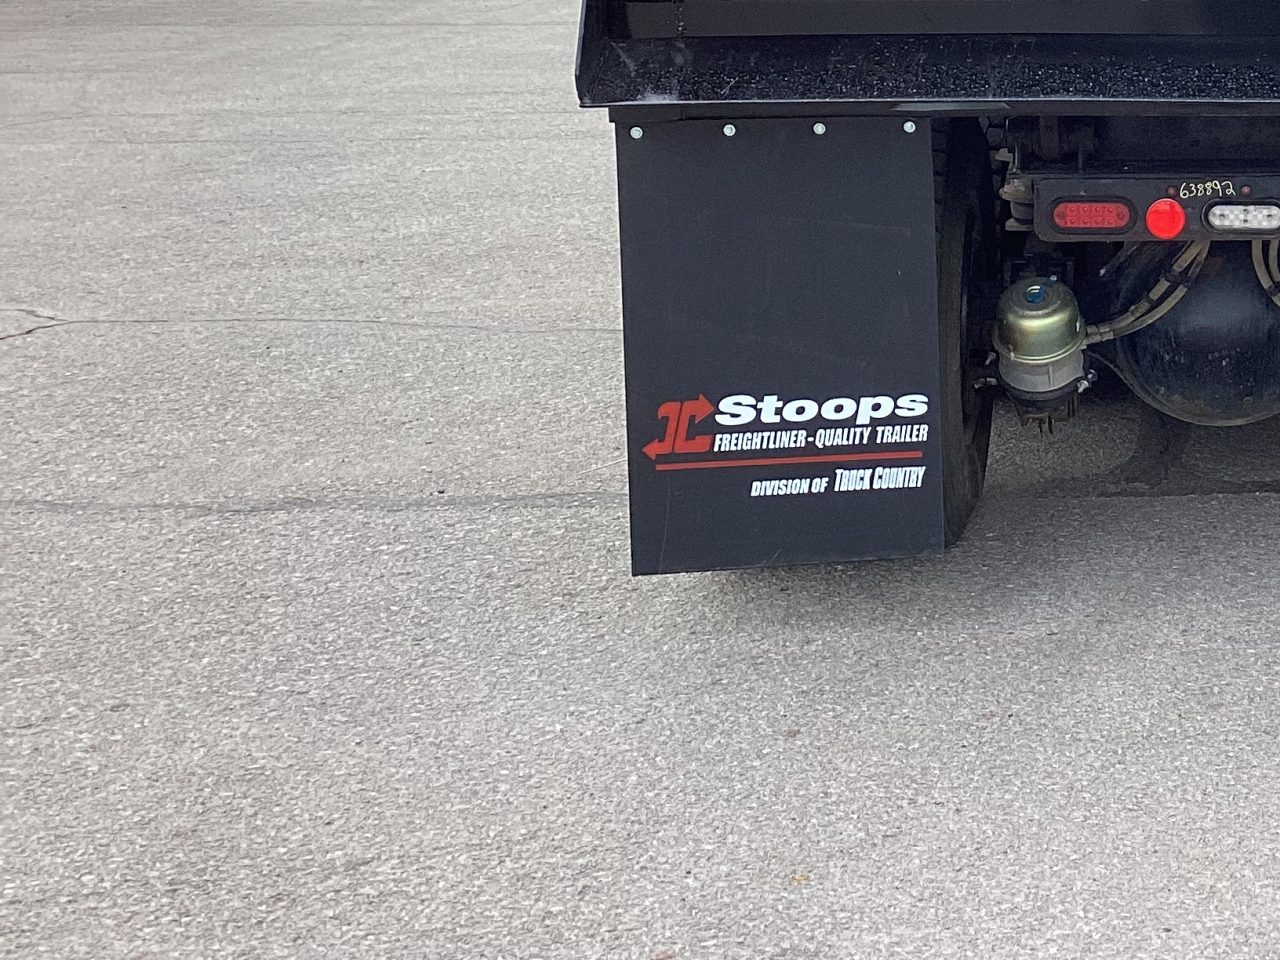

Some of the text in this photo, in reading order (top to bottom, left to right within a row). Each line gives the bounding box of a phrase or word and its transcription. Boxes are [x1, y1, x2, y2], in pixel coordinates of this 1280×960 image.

[1180, 180, 1236, 199] 638892
[714, 394, 929, 426] Stoops
[875, 424, 929, 444] TRAILER
[750, 466, 926, 497] DIVISION OF TRUCK COUNTRY
